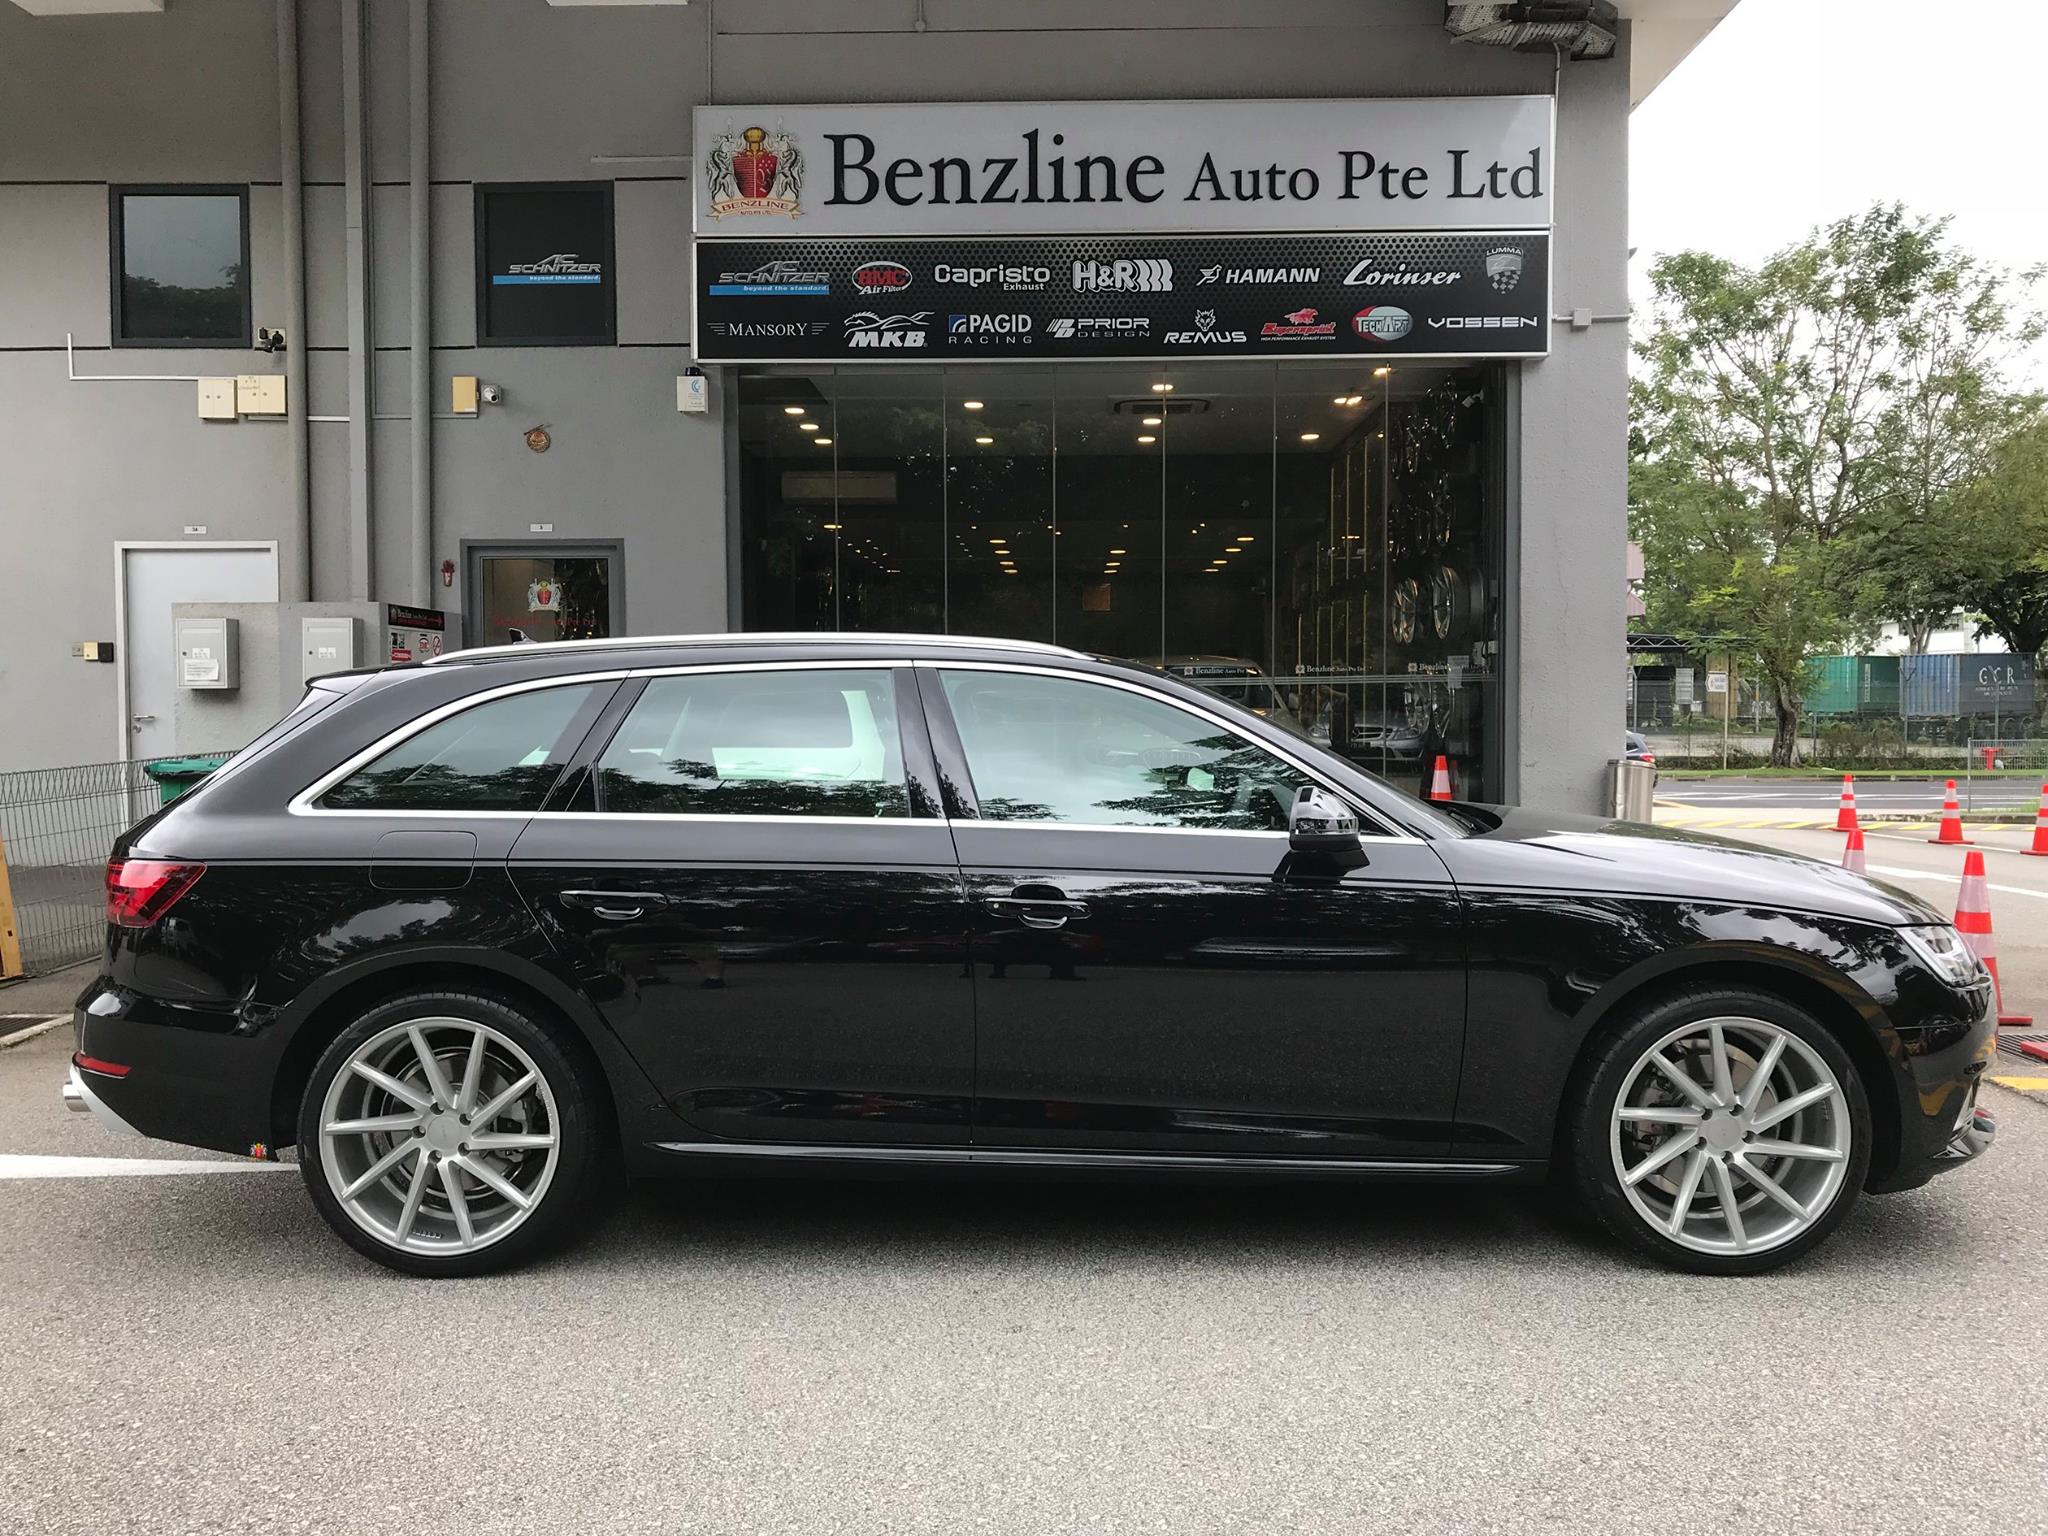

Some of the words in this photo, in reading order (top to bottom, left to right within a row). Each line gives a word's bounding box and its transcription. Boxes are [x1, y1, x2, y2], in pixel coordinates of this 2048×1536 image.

[823, 128, 1165, 206] Benzline
[1183, 151, 1320, 201] Auto
[1338, 151, 1429, 200] Pte
[1447, 146, 1544, 199] Ltd
[721, 200, 789, 211] BENZLINE
[1486, 246, 1523, 256] LUMMA
[508, 264, 601, 274] SCHNITZER
[934, 264, 1050, 287] Capristo
[1072, 259, 1140, 292] H&R
[1225, 268, 1320, 284] HAMANN
[1343, 258, 1462, 286] Lorinser
[718, 272, 830, 283] SCHNITZER
[858, 270, 907, 286] BMC
[859, 285, 882, 295] Air
[1003, 283, 1045, 291] Exhaust
[728, 322, 808, 336] MANSORY
[969, 314, 1032, 333] PAGID
[1077, 317, 1150, 329] PRIOR
[1427, 316, 1538, 329] VOSSEN
[848, 331, 926, 348] MKB
[949, 336, 1032, 344] RACING
[1163, 331, 1248, 345] REMUS
